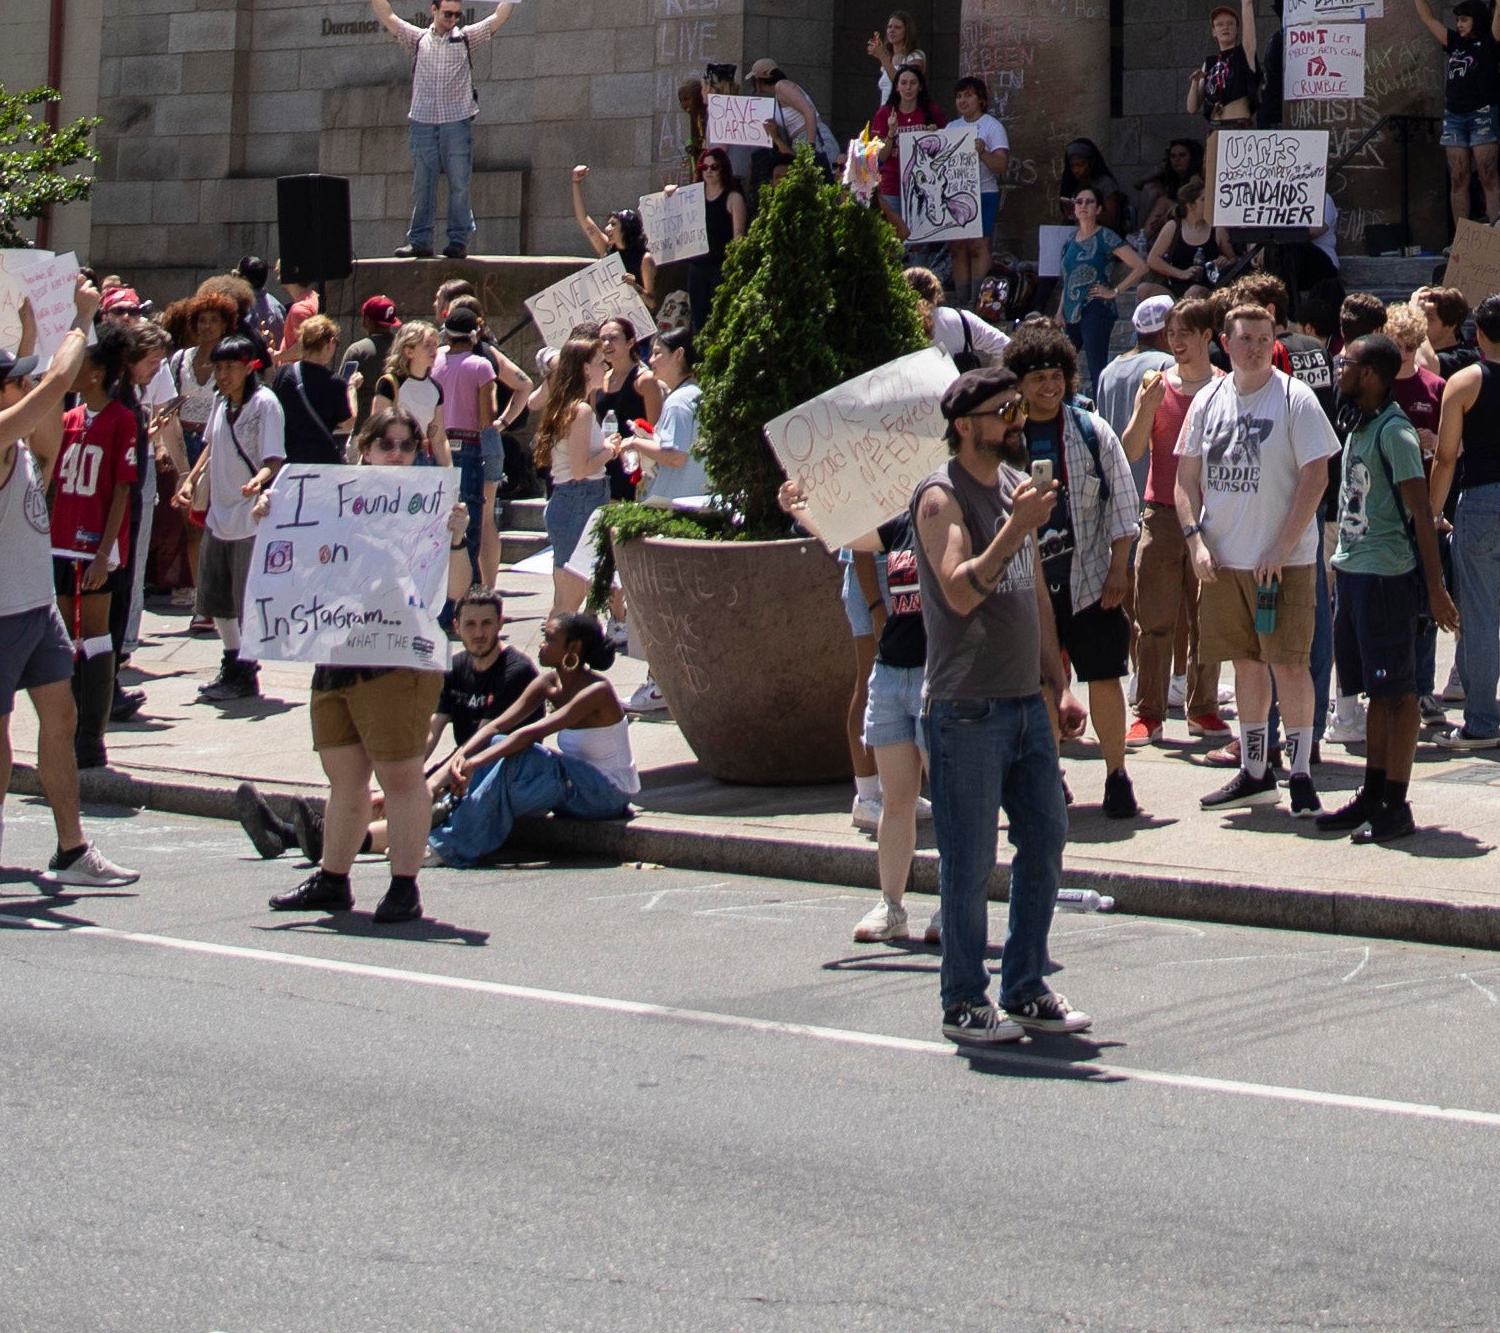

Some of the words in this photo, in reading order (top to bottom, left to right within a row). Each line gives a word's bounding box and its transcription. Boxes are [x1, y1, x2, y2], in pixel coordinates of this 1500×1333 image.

[321, 18, 380, 36] Dorrance
[1332, 32, 1352, 44] LET
[1292, 79, 1349, 96] CRUMBLE
[710, 95, 762, 121] SAVE
[677, 188, 698, 207] THE
[533, 274, 591, 326] SAVE
[588, 259, 625, 297] THE
[783, 395, 864, 462] OUR
[880, 396, 936, 439] Failed
[58, 442, 105, 497] 40
[859, 430, 920, 485] NEED
[1207, 465, 1261, 482] EDDIE
[1207, 479, 1260, 494] MUNSON
[276, 473, 321, 529] I
[336, 479, 401, 519] Found
[407, 480, 446, 517] out
[318, 541, 349, 565] on
[346, 632, 379, 649] WHAT
[386, 632, 410, 649] THE
